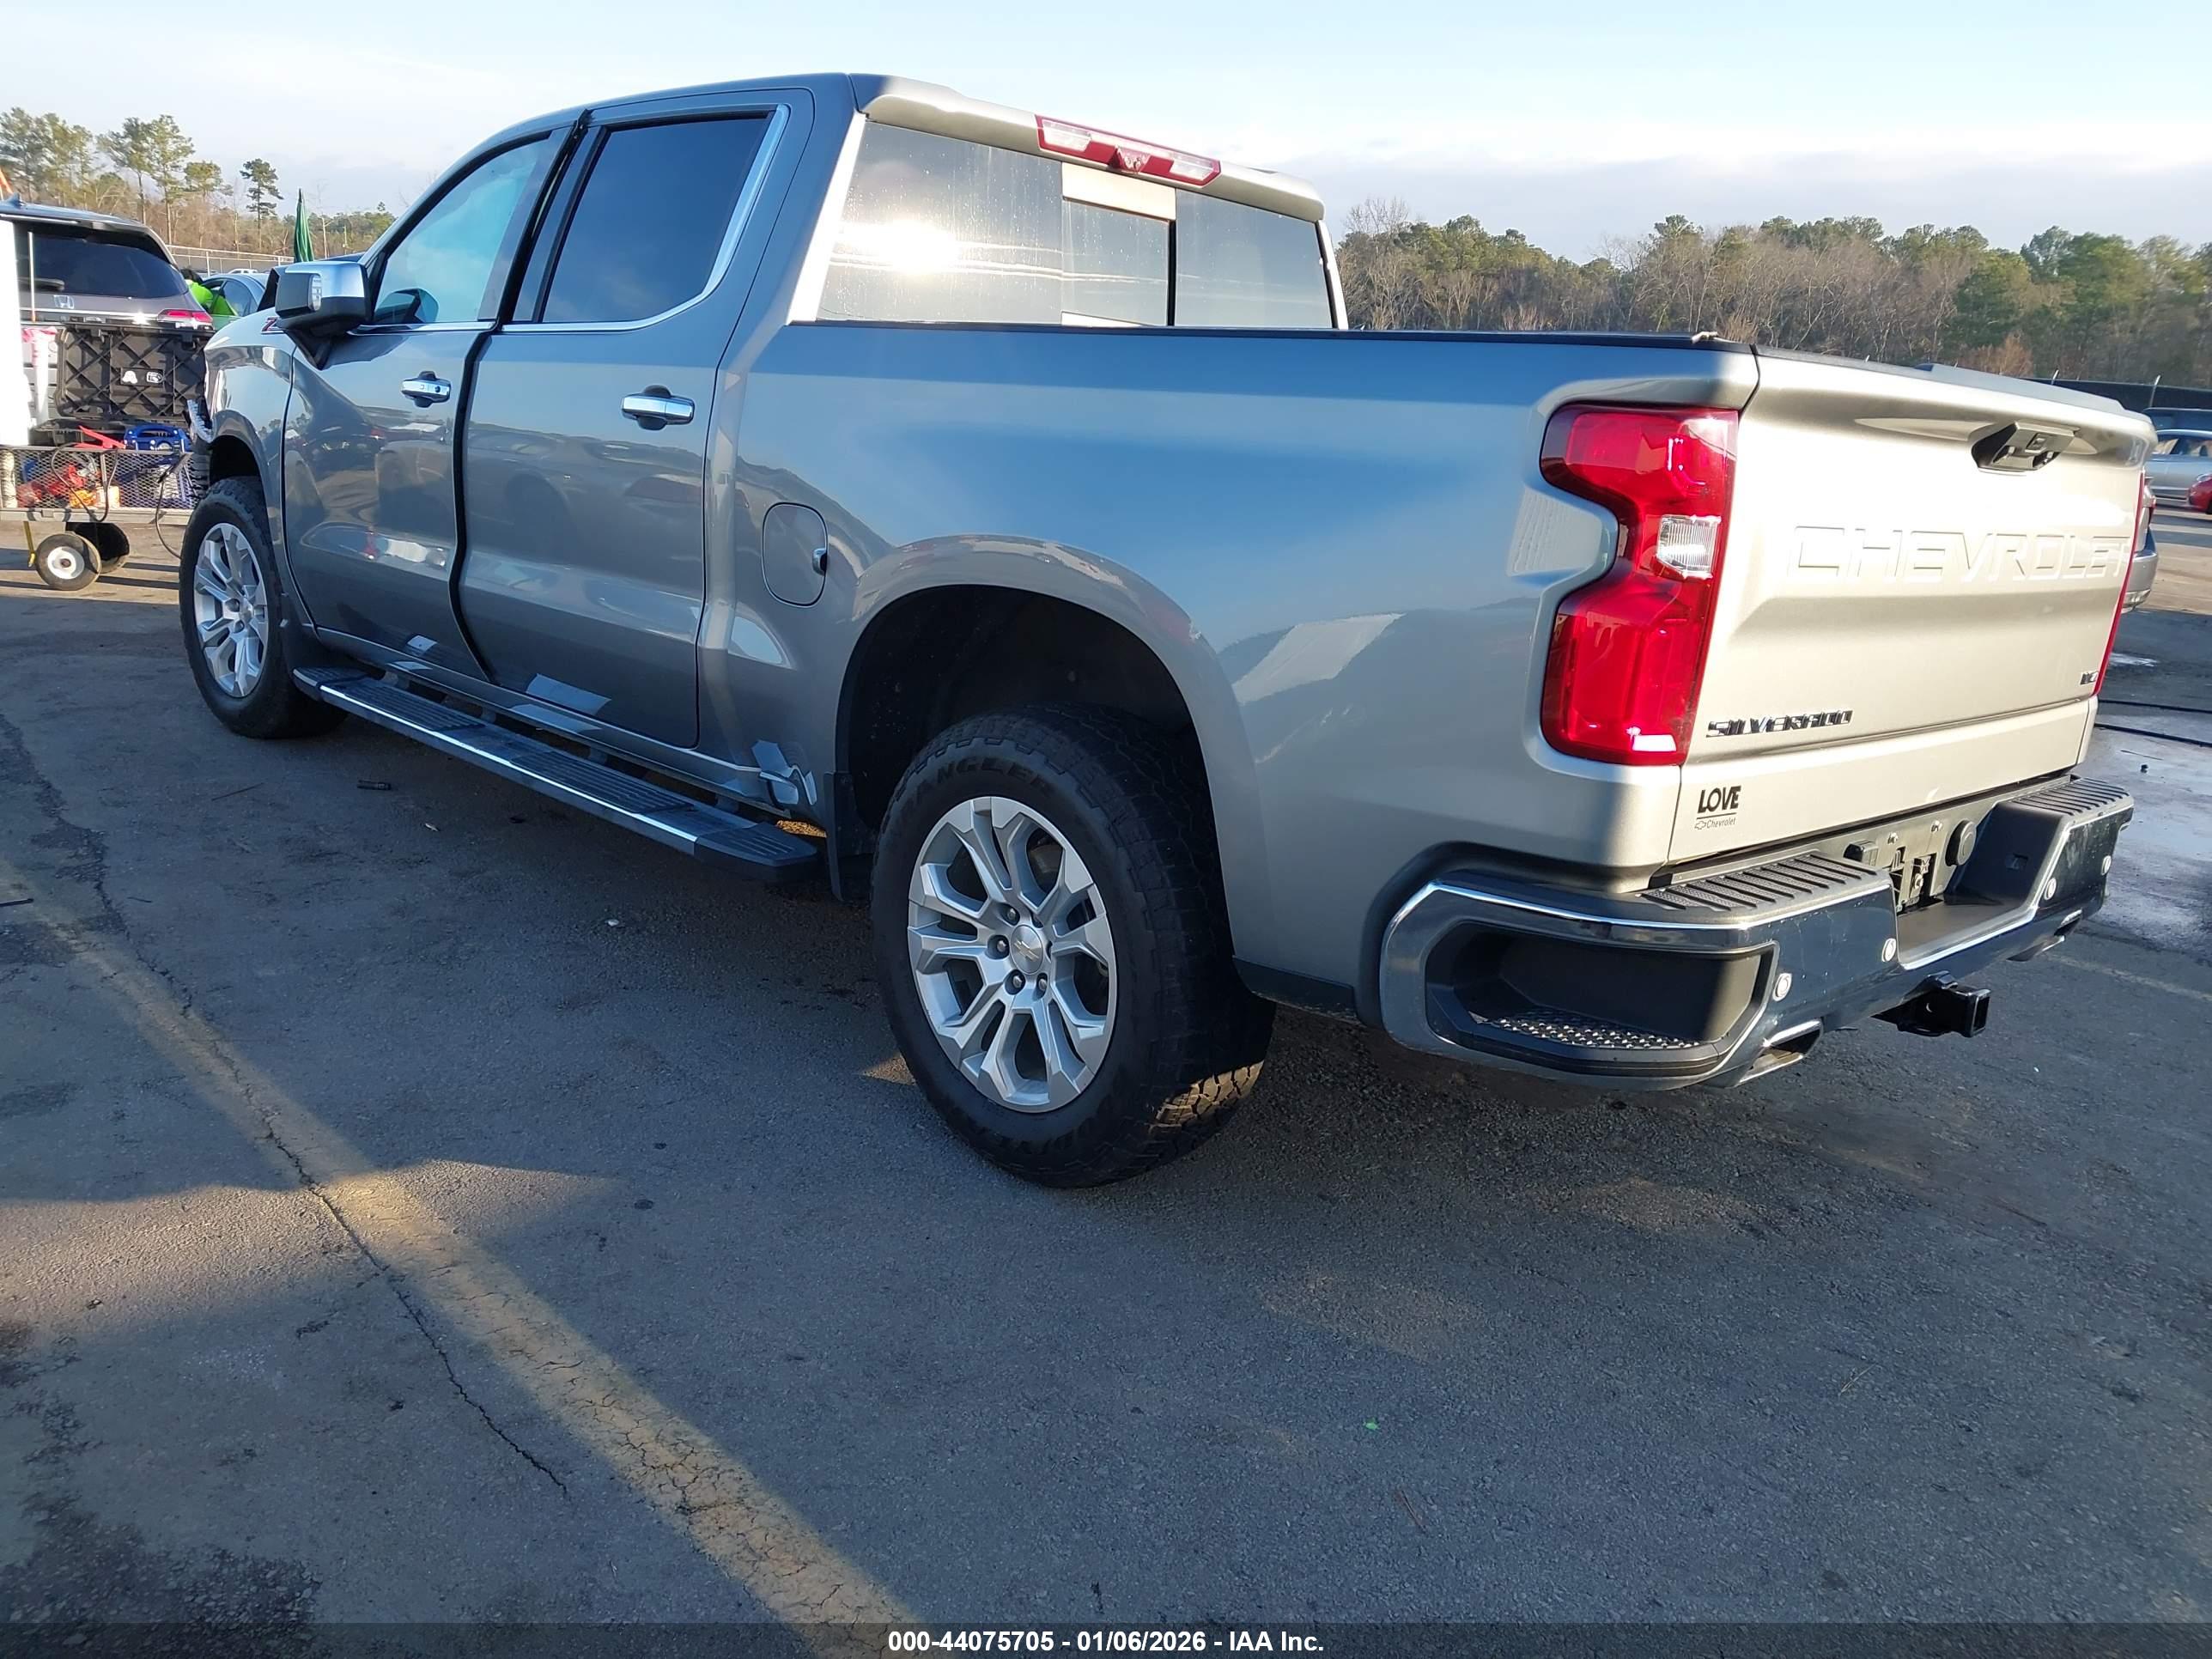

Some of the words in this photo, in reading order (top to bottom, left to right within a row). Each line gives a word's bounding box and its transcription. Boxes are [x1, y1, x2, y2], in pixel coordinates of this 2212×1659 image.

[1785, 525, 2131, 582] CHEVROLET
[1705, 710, 1853, 738] SILVERADO
[1697, 785, 1741, 814] LOVE
[1706, 817, 1736, 830] Chevrolet
